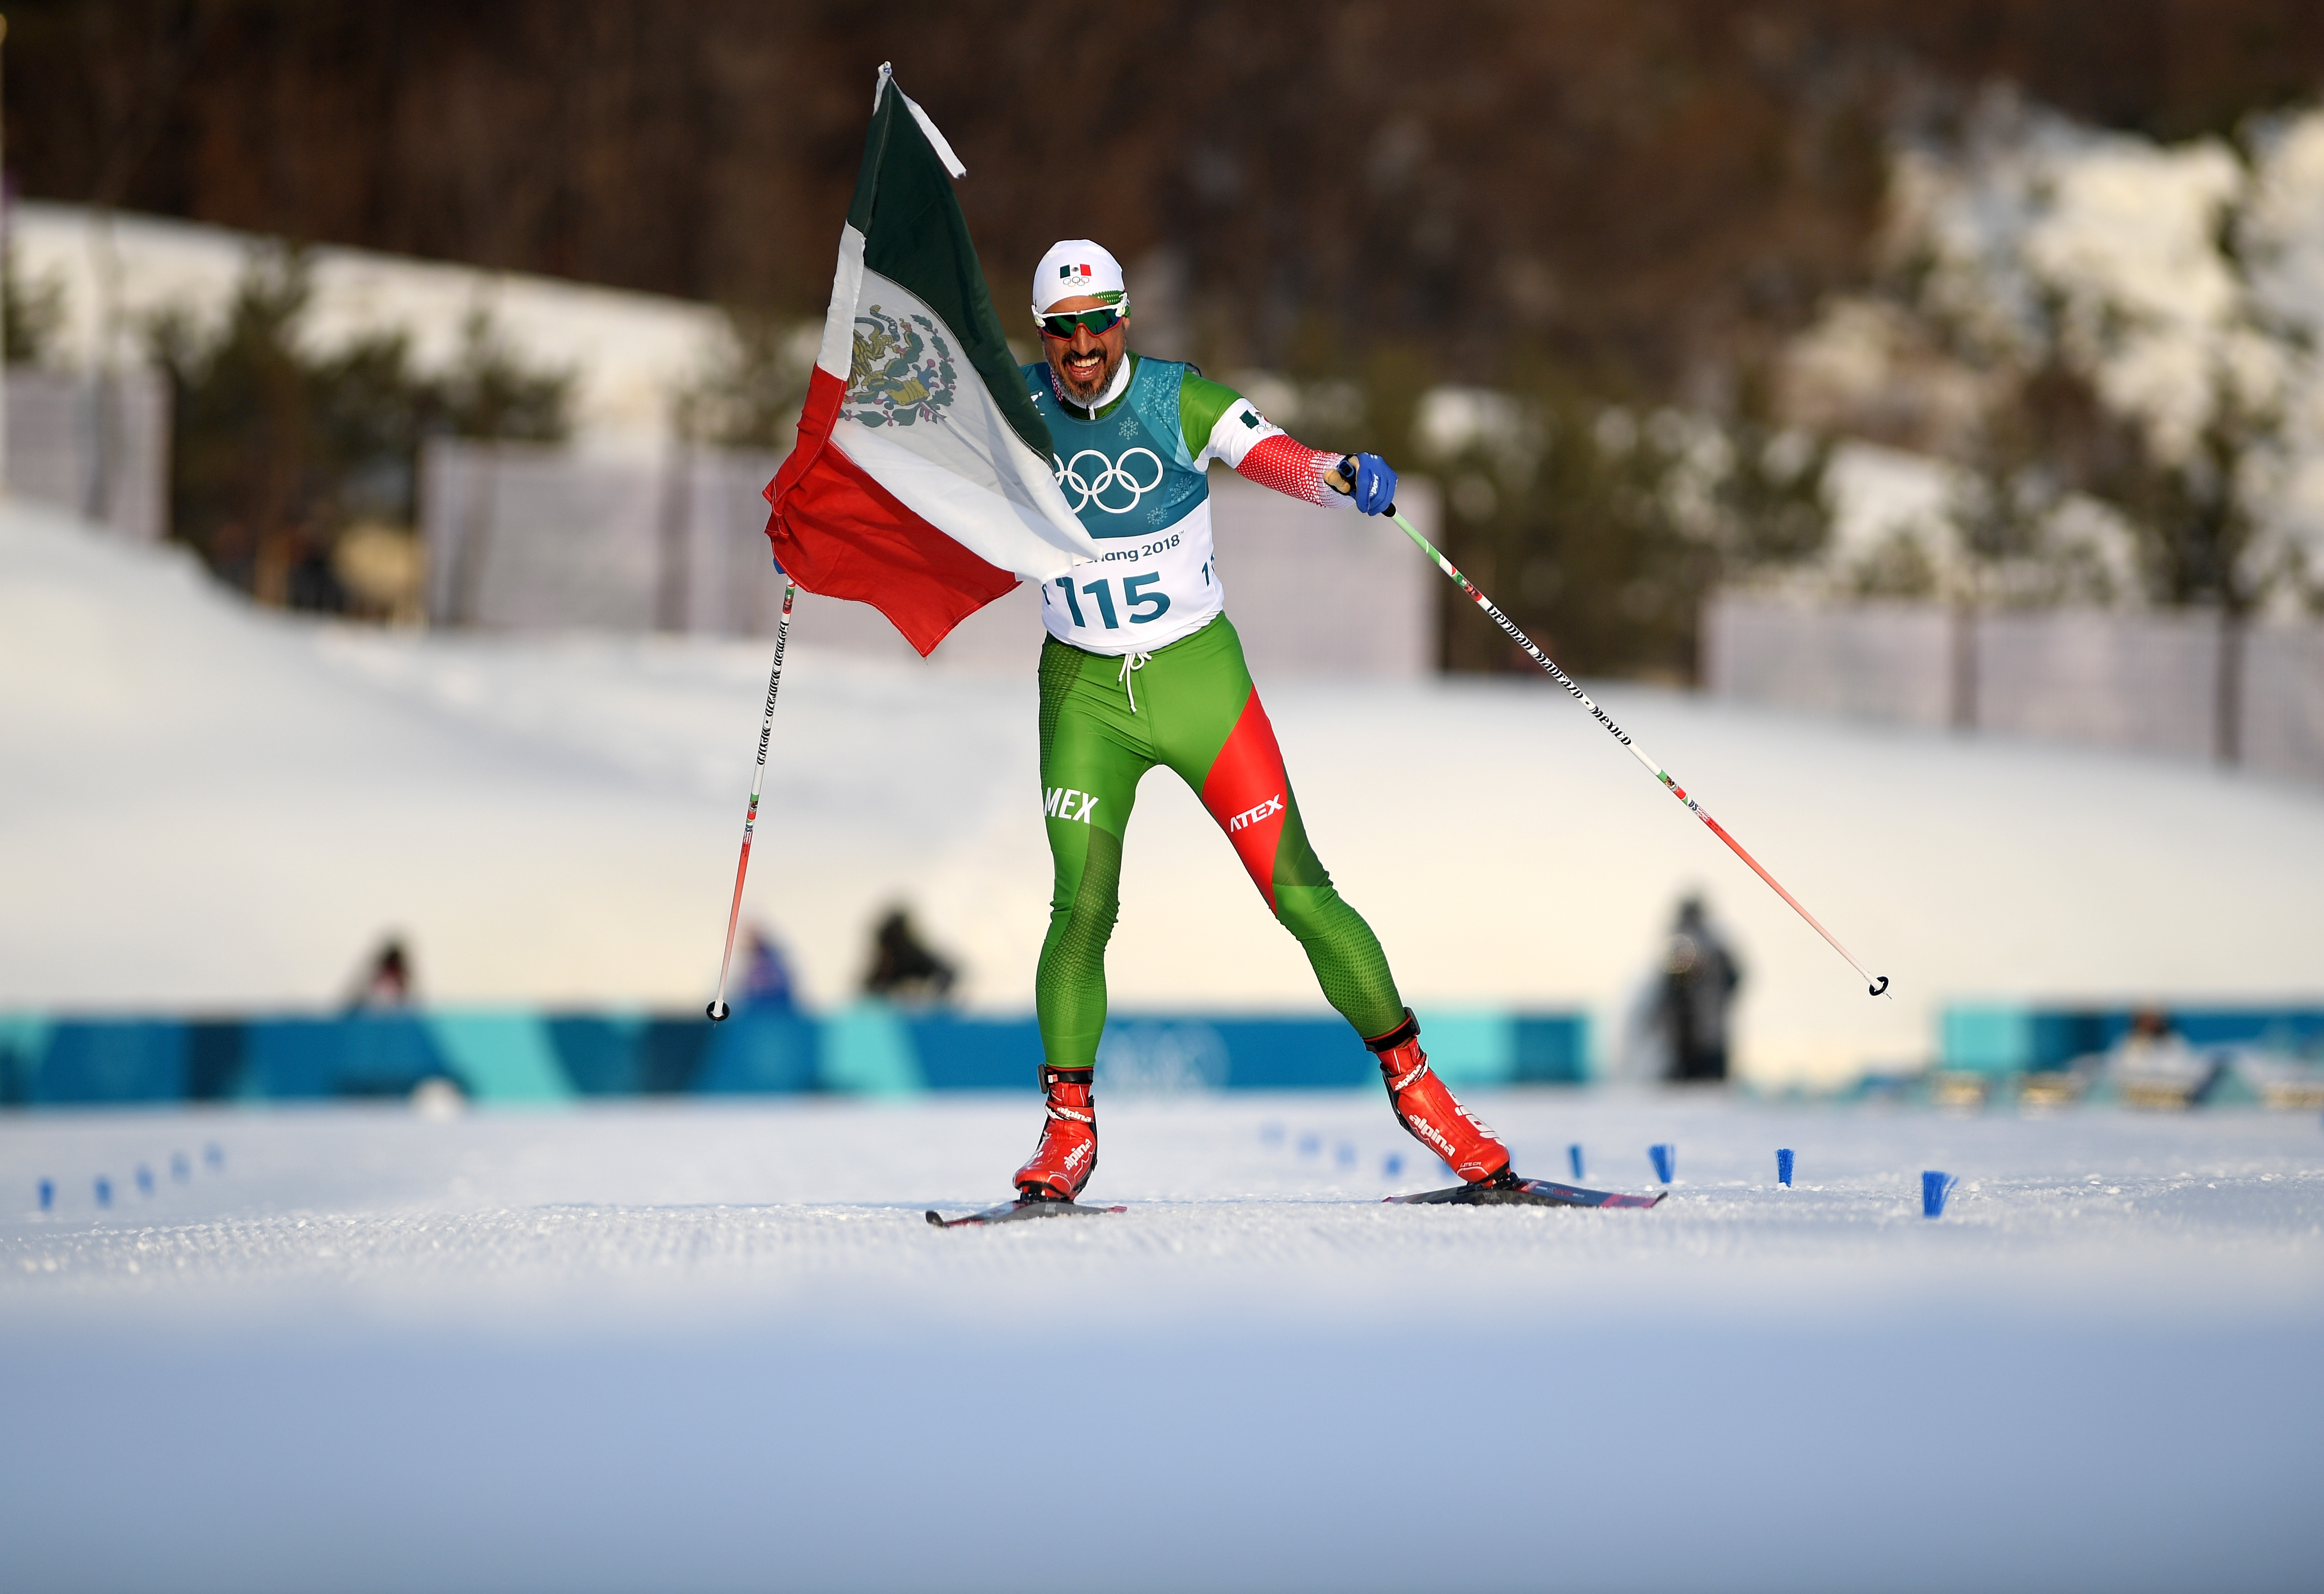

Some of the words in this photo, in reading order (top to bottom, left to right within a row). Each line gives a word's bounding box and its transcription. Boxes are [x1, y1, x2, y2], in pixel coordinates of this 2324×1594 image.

[1141, 534, 1180, 557] 2018
[1055, 571, 1171, 629] 115
[1044, 787, 1099, 824] MEX
[1230, 793, 1284, 832] ATEX
[1395, 1064, 1422, 1091] alpina
[1057, 1107, 1092, 1123] alpina
[1409, 1114, 1456, 1157] alpina
[1063, 1138, 1093, 1171] alpina
